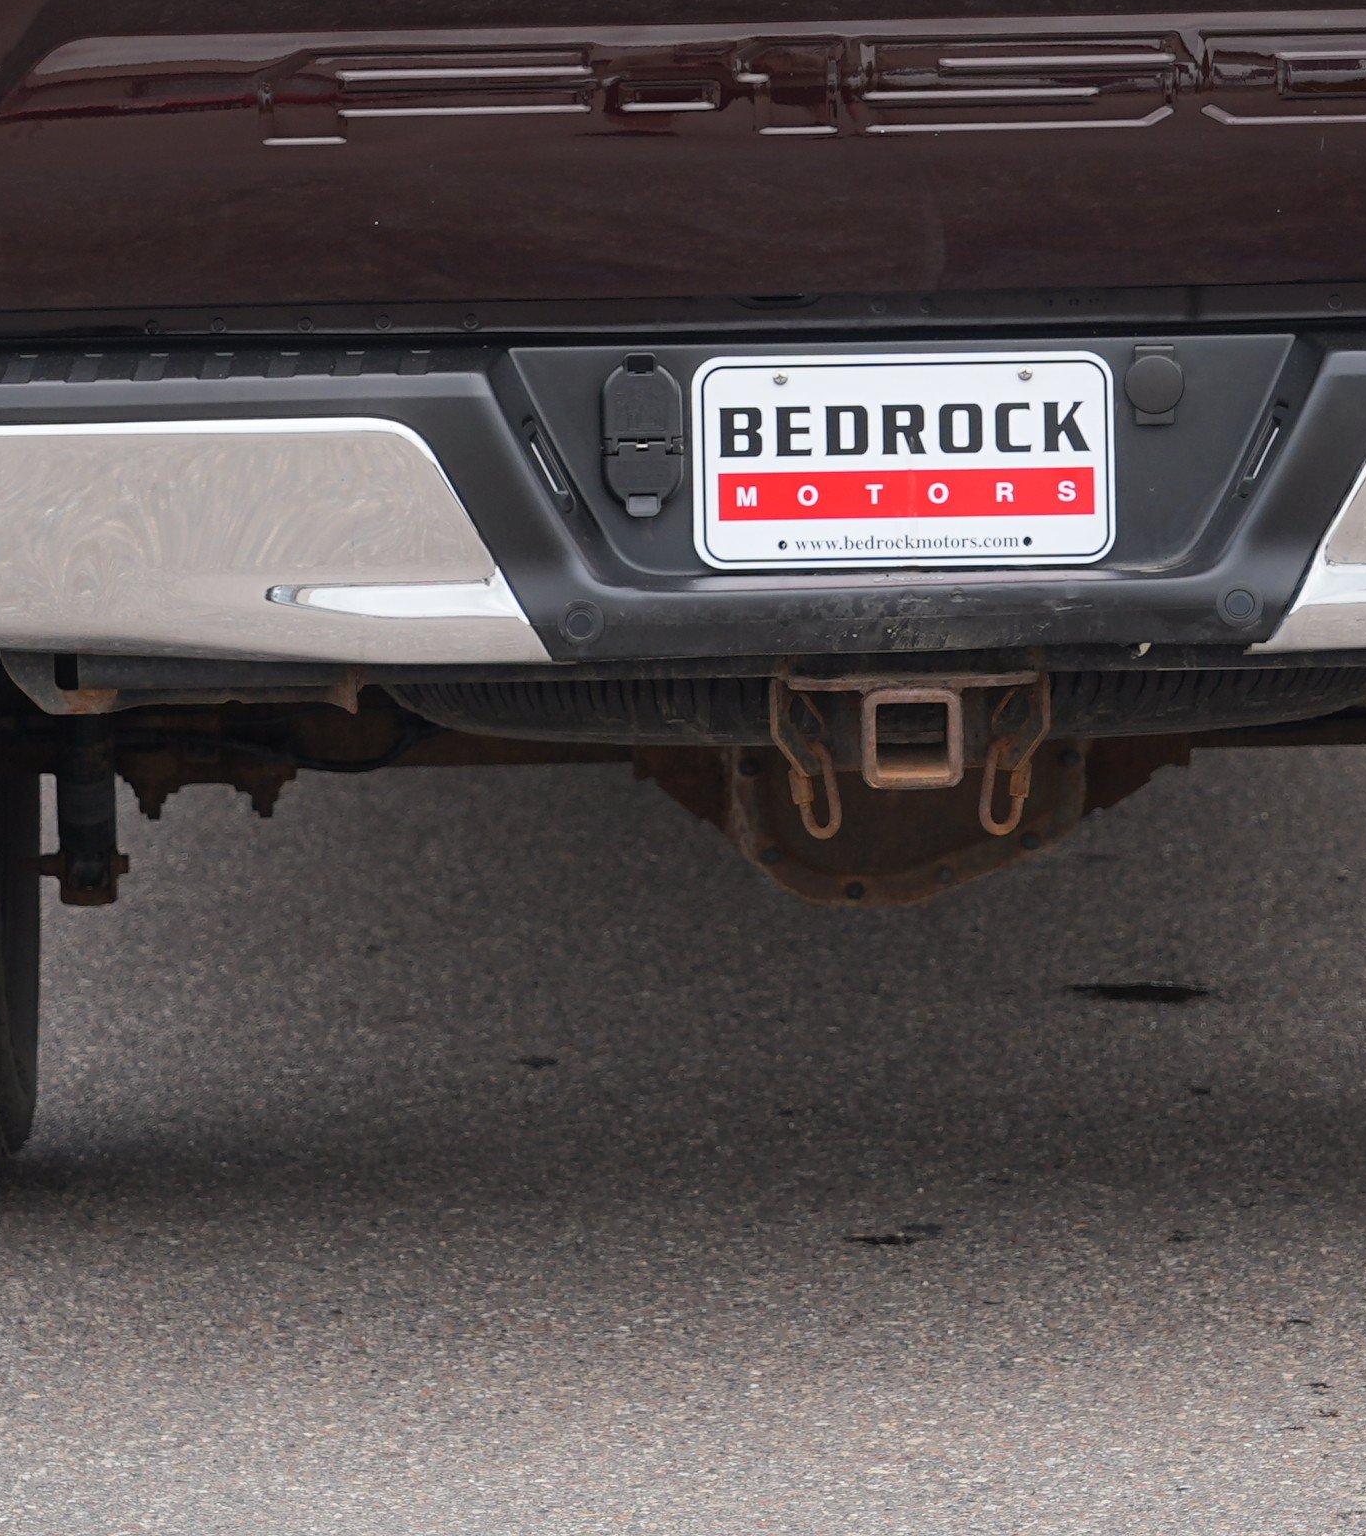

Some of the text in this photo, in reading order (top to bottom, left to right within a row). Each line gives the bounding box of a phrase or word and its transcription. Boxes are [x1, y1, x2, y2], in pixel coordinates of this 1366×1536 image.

[719, 401, 1090, 458] BEDROCK
[735, 480, 1077, 507] MOTORS
[795, 534, 1020, 552] www.bedrockmotors.com
